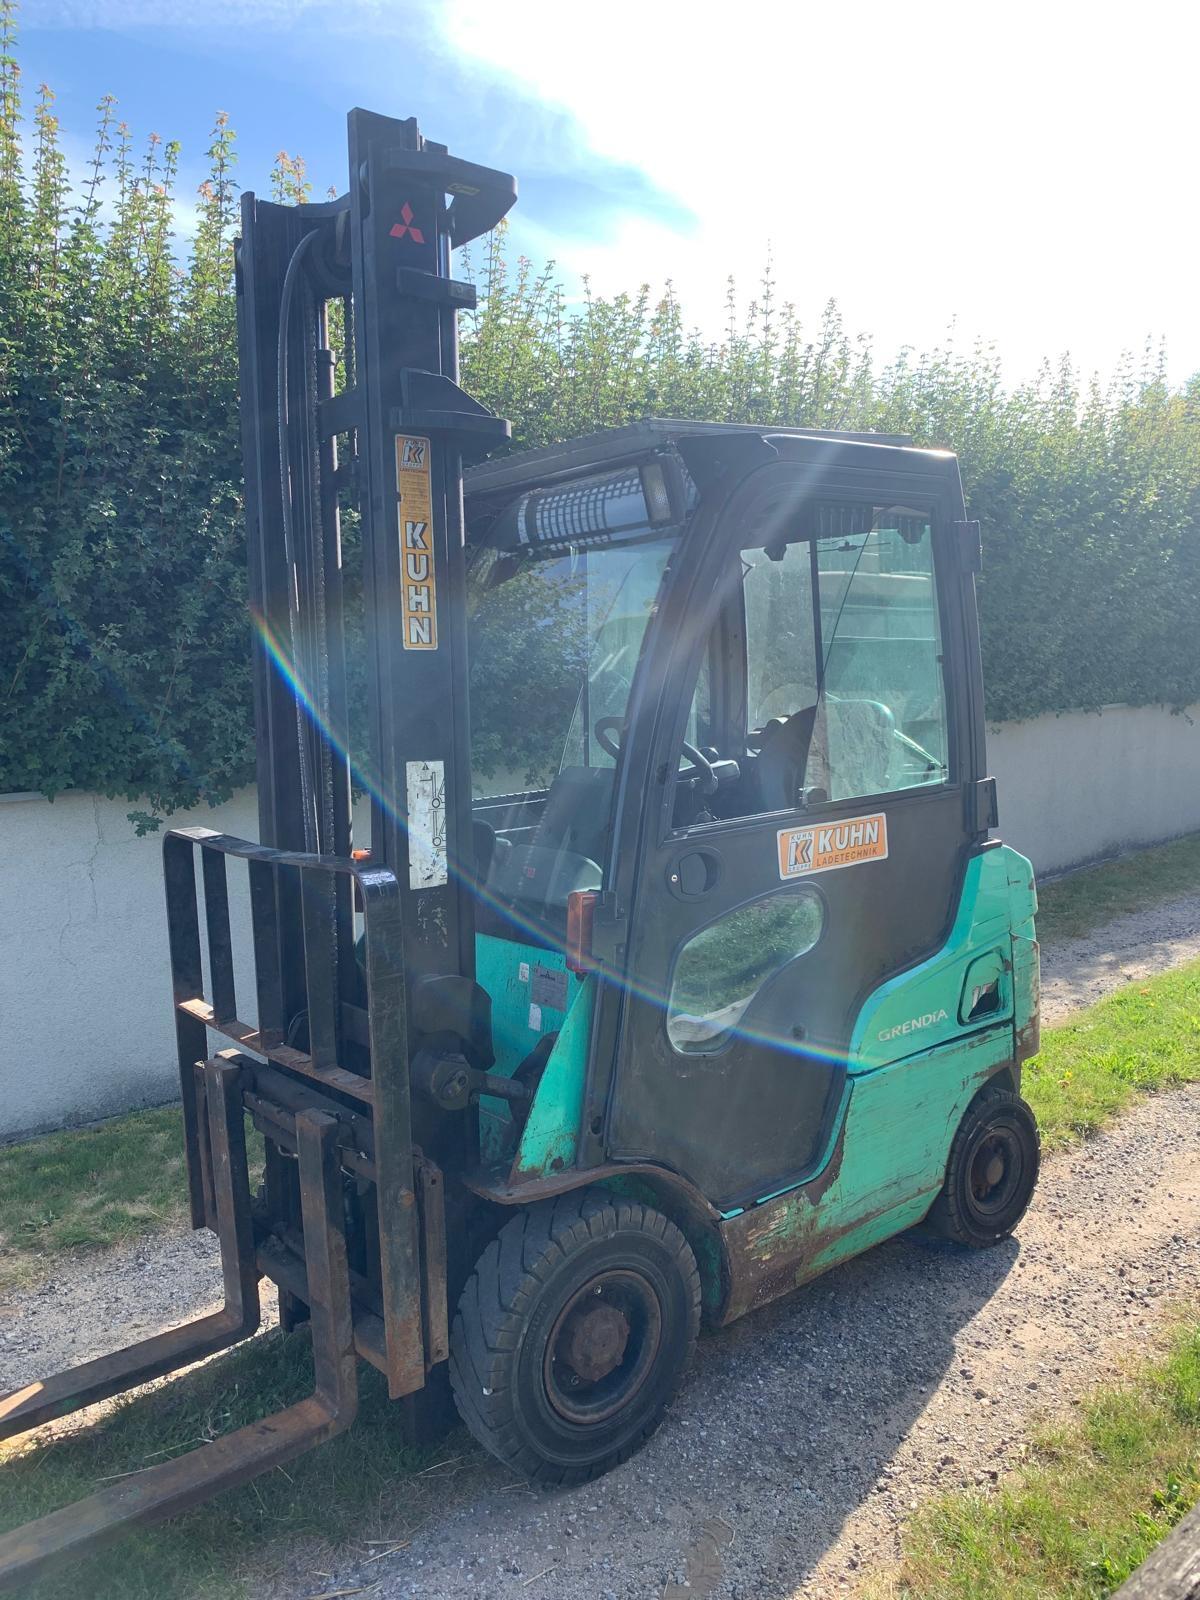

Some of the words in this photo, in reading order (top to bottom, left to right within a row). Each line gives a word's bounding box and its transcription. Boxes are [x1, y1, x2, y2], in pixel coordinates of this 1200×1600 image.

[405, 521, 432, 644] KUHN
[791, 832, 813, 841] KUHN
[818, 820, 880, 854] KUHN
[816, 847, 878, 867] LADETECHNIK
